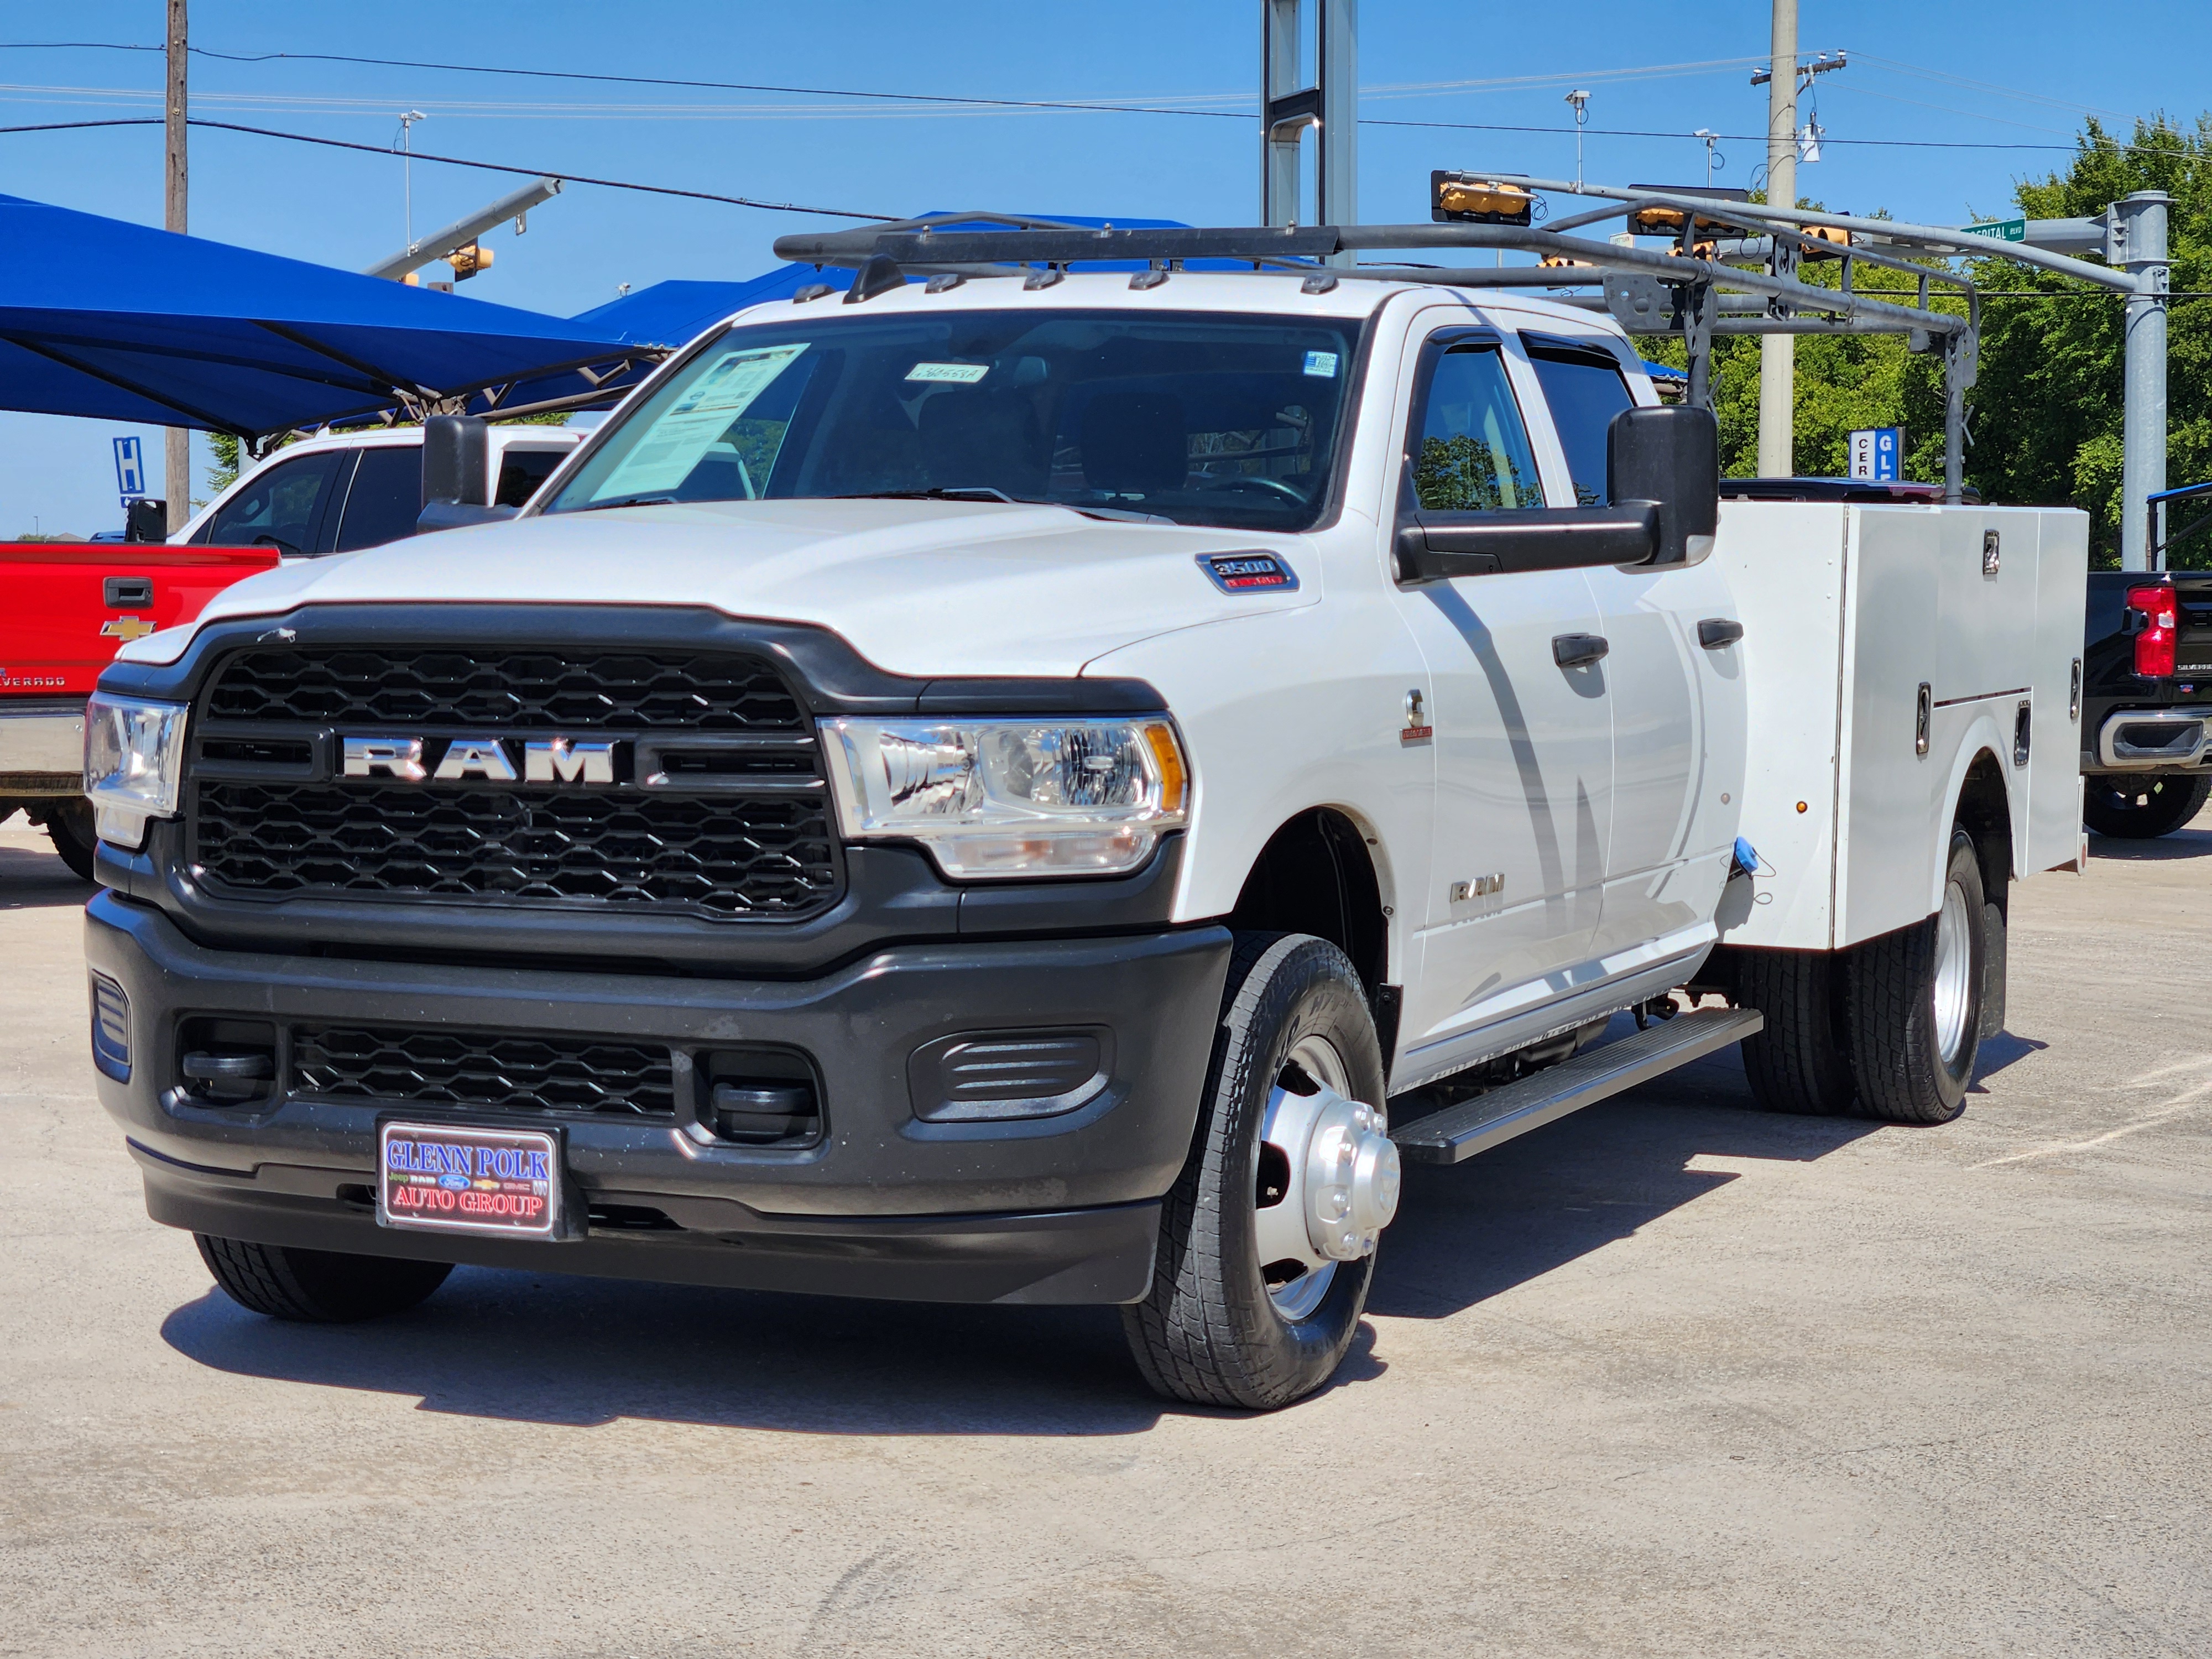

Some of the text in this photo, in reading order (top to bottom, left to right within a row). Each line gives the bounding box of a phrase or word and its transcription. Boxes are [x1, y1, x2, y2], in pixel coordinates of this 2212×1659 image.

[2010, 226, 2022, 236] BLVD
[1214, 560, 1276, 576] 3500
[0, 677, 65, 686] VERADO
[343, 737, 614, 783] RAM
[1449, 872, 1505, 904] RAM
[387, 1140, 550, 1180] GLENN POLK
[389, 1172, 409, 1183] Jeep
[503, 1182, 530, 1191] GMC
[393, 1185, 543, 1216] AUTO GROUP
